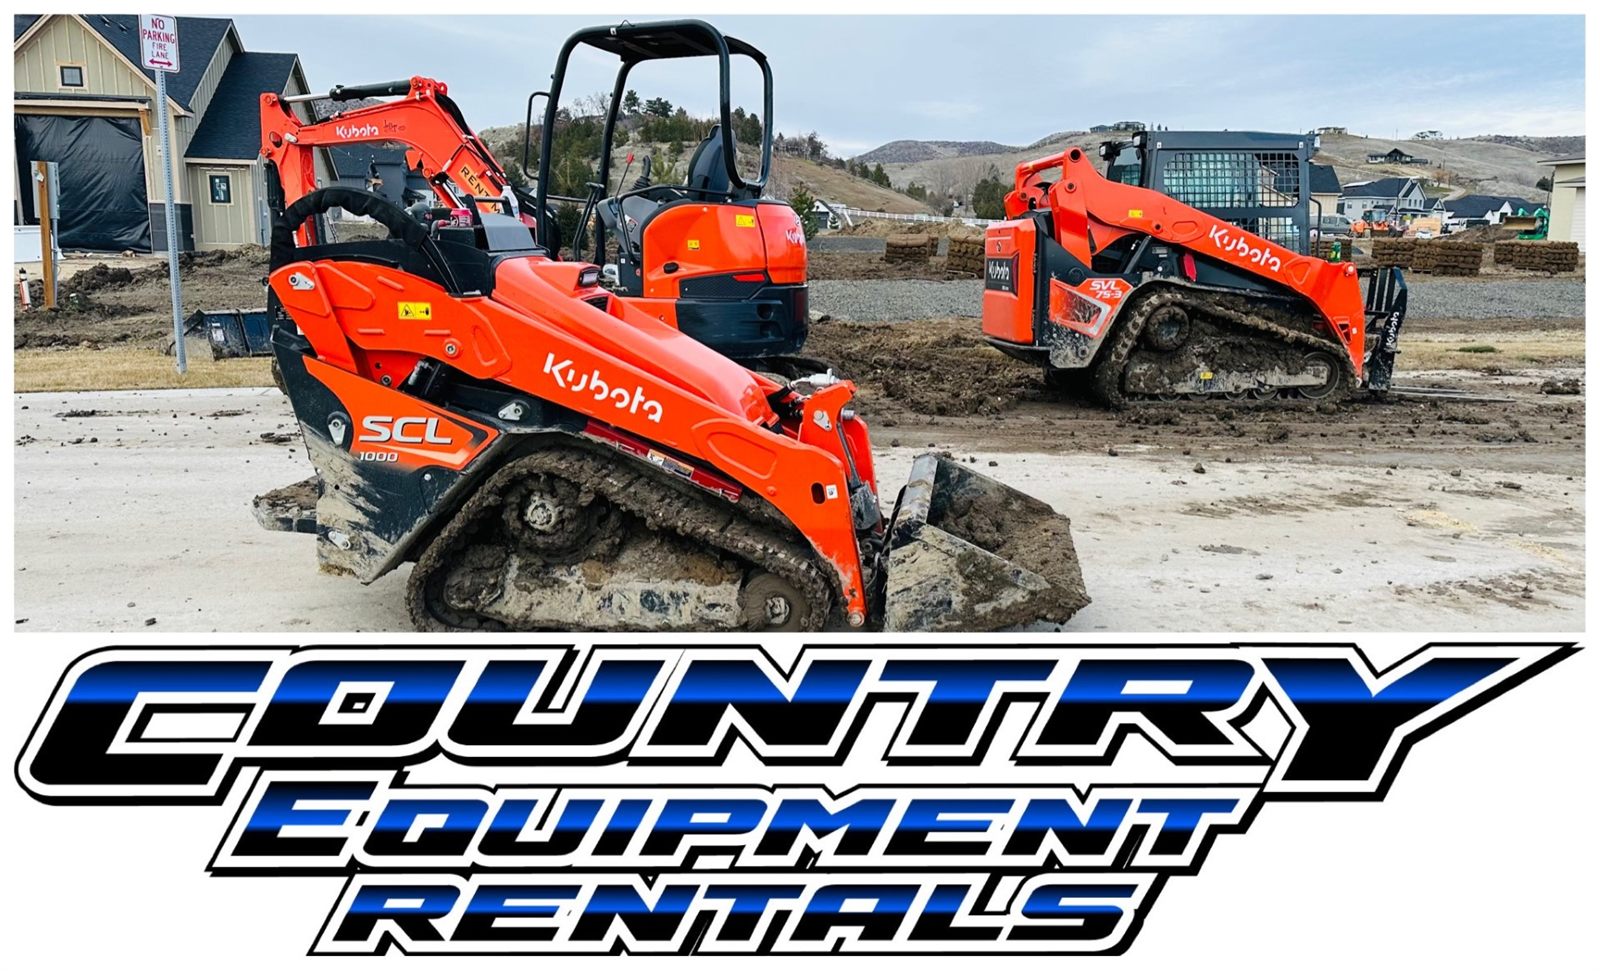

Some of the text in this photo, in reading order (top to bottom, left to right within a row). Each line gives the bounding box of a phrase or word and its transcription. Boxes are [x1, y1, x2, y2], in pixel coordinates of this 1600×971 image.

[151, 18, 165, 30] NO
[142, 29, 175, 44] PARKING
[152, 42, 167, 51] FIRE
[151, 51, 169, 59] LANE
[335, 123, 379, 139] Kubota
[1208, 224, 1281, 273] Kubota
[988, 260, 1010, 281] Kubota
[1089, 280, 1121, 291] SVL
[1095, 290, 1123, 299] 75-3
[1385, 311, 1400, 346] Kubota
[543, 352, 663, 424] Kubota
[359, 415, 453, 445] SCL
[359, 451, 399, 462] 1000
